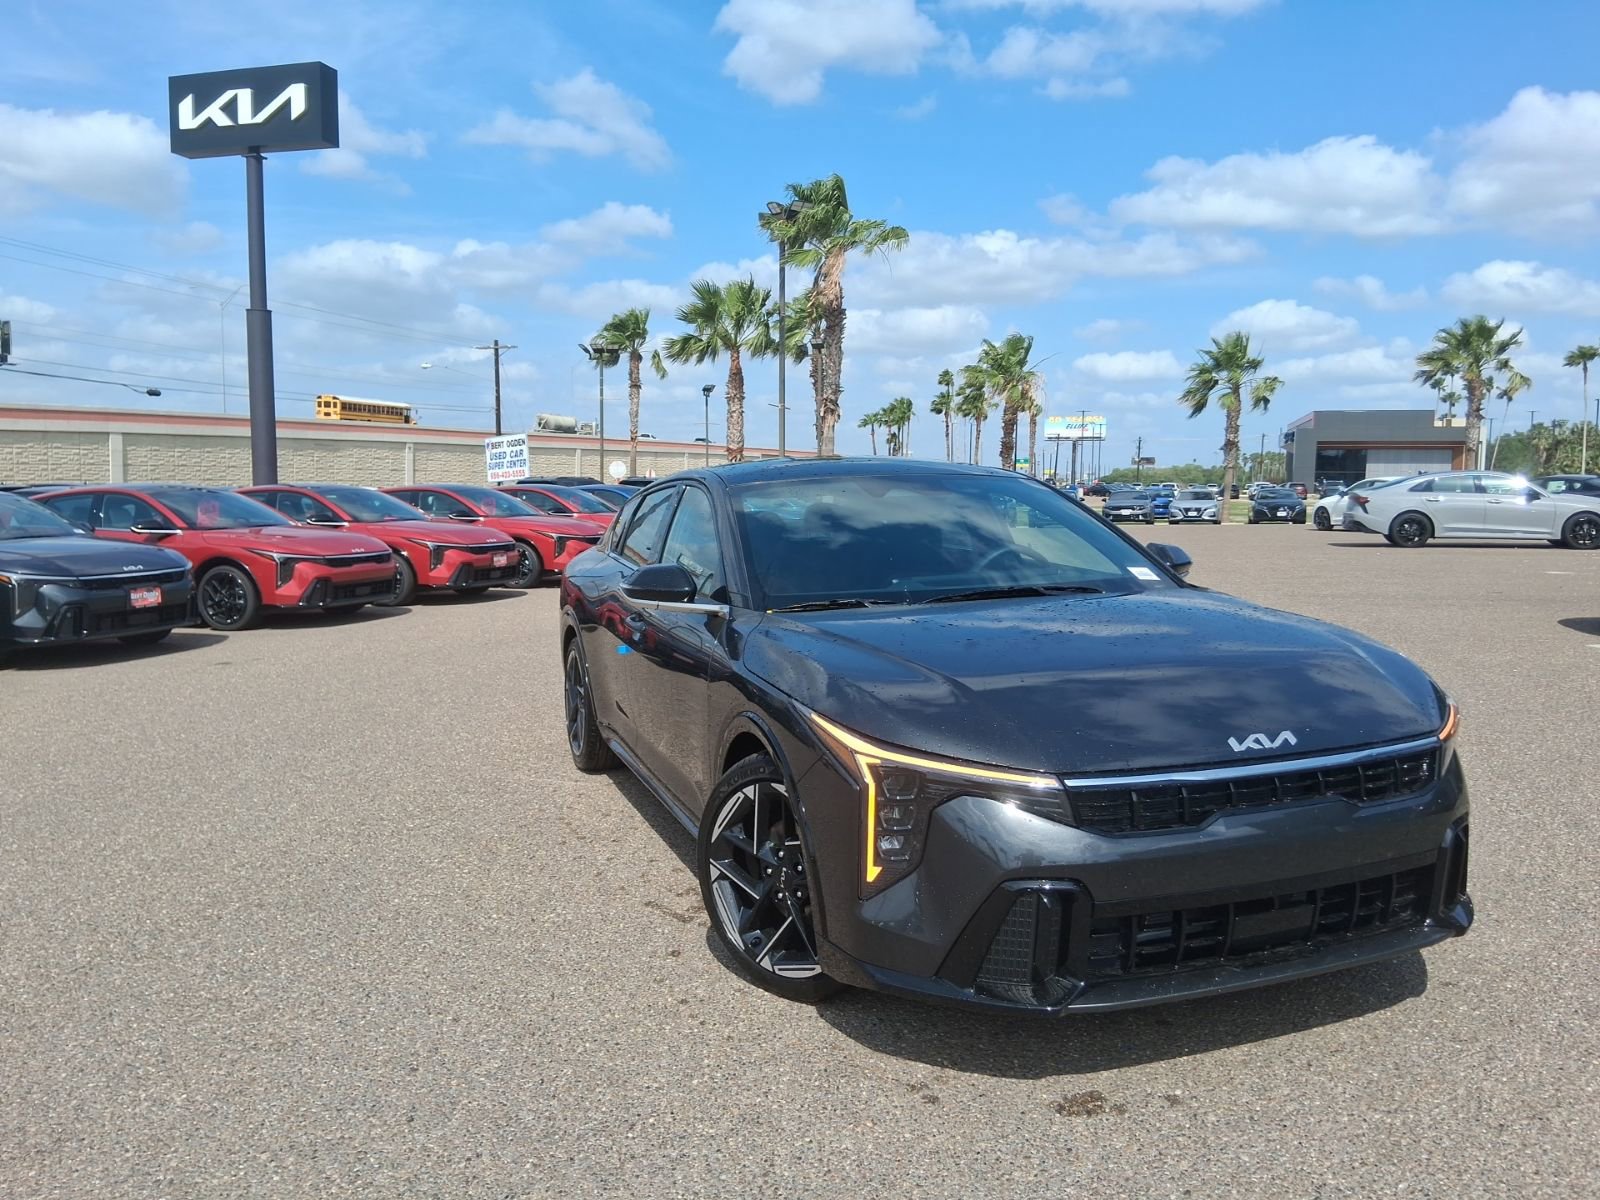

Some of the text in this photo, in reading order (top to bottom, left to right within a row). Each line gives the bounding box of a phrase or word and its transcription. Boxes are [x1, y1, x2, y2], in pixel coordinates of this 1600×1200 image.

[178, 82, 307, 130] KIA
[490, 438, 526, 450] BERT OGDEN
[489, 449, 524, 461] USED CAR
[488, 458, 527, 471] SUPER CENTER
[1227, 730, 1298, 752] KIA
